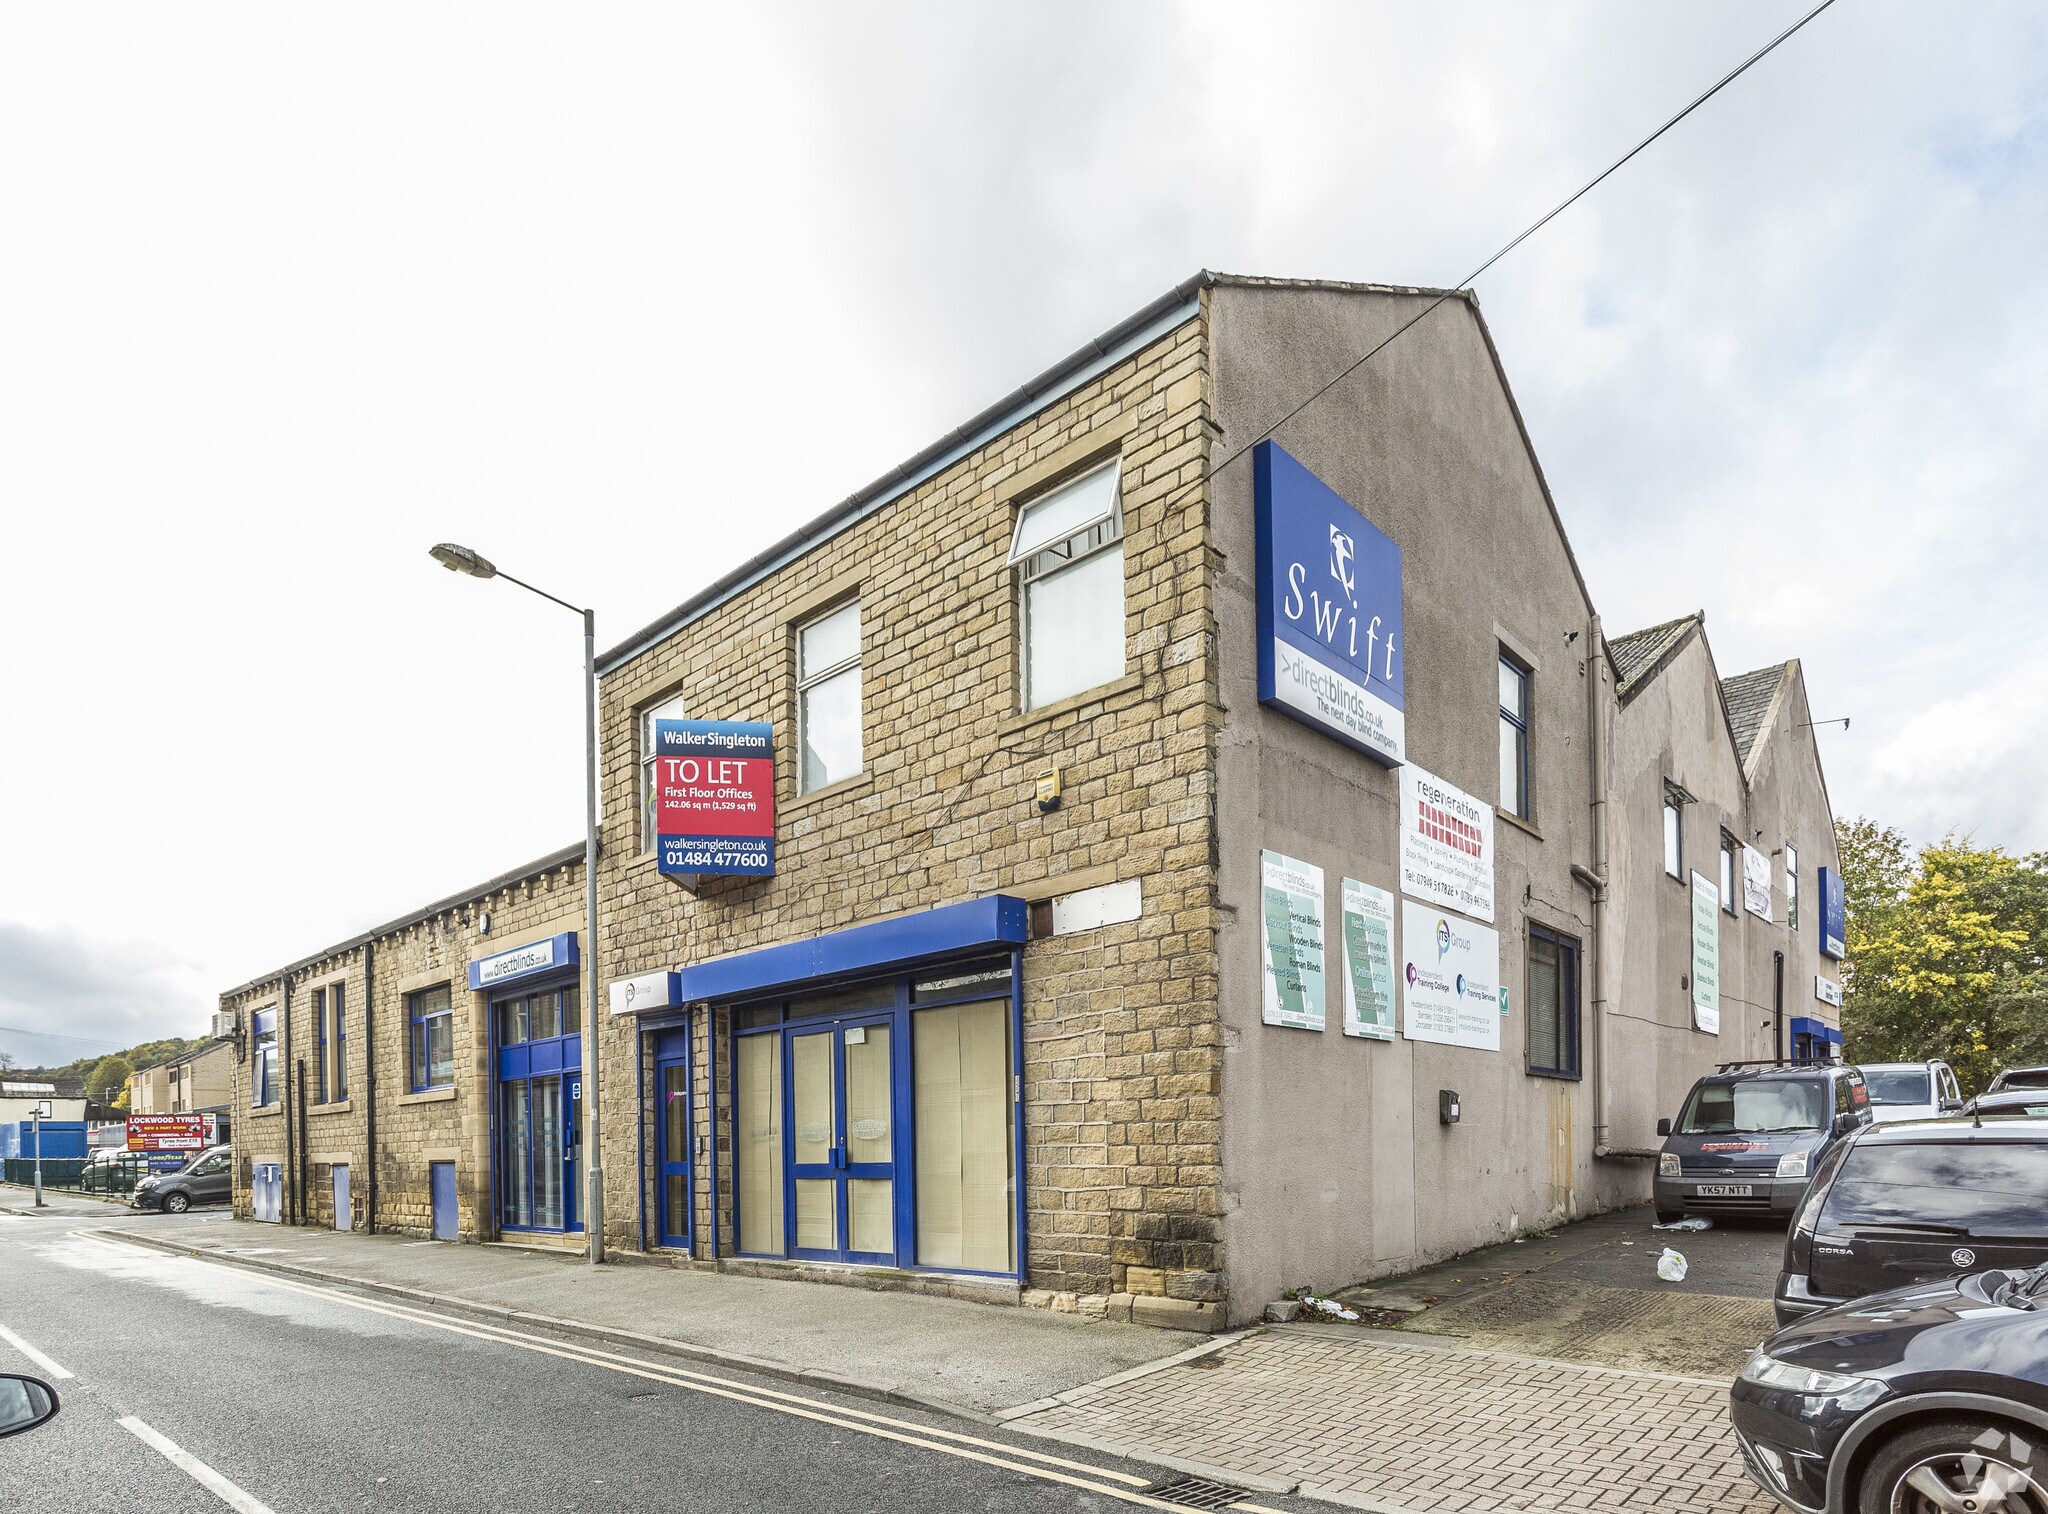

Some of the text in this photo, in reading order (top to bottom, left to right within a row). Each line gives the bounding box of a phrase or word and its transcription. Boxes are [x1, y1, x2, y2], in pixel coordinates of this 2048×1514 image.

[1284, 562, 1396, 686] Swift
[1317, 696, 1329, 714] The
[1331, 705, 1344, 724] next
[1346, 712, 1357, 731] day
[1358, 718, 1371, 738] blind
[665, 759, 747, 784] TO LET
[665, 787, 753, 799] First Floor Offices
[665, 801, 690, 809] 142.06
[693, 802, 702, 811] sq
[713, 801, 735, 811] (1,529
[747, 802, 756, 812] ft)
[1417, 780, 1481, 823] regeneration
[665, 838, 766, 852] walkersingleton.co.uk
[667, 852, 768, 867] 01484 477600
[1405, 869, 1416, 883] Tel:
[1417, 873, 1432, 889] 07949
[1434, 861, 1453, 875] Landscape
[1455, 868, 1471, 883] Gardening
[1266, 917, 1302, 935] Blackout Blinds
[1289, 911, 1321, 928] Vertical Blinds
[1267, 941, 1304, 957] Venetian Blinds
[1289, 934, 1323, 950] Wooden Blinds
[1370, 940, 1381, 952] made
[1439, 930, 1471, 953] ITS Group
[1290, 958, 1320, 973] Roman Blinds
[1374, 954, 1386, 966] blinds
[1267, 964, 1301, 980] Pleated Blinds
[1355, 965, 1372, 980] Online
[1417, 968, 1443, 981] Independent
[636, 986, 651, 994] Group
[1287, 980, 1306, 993] Curtains
[1417, 978, 1449, 993] Training College
[1467, 988, 1496, 1002] Training Services
[1818, 1247, 1854, 1255] CORSA
